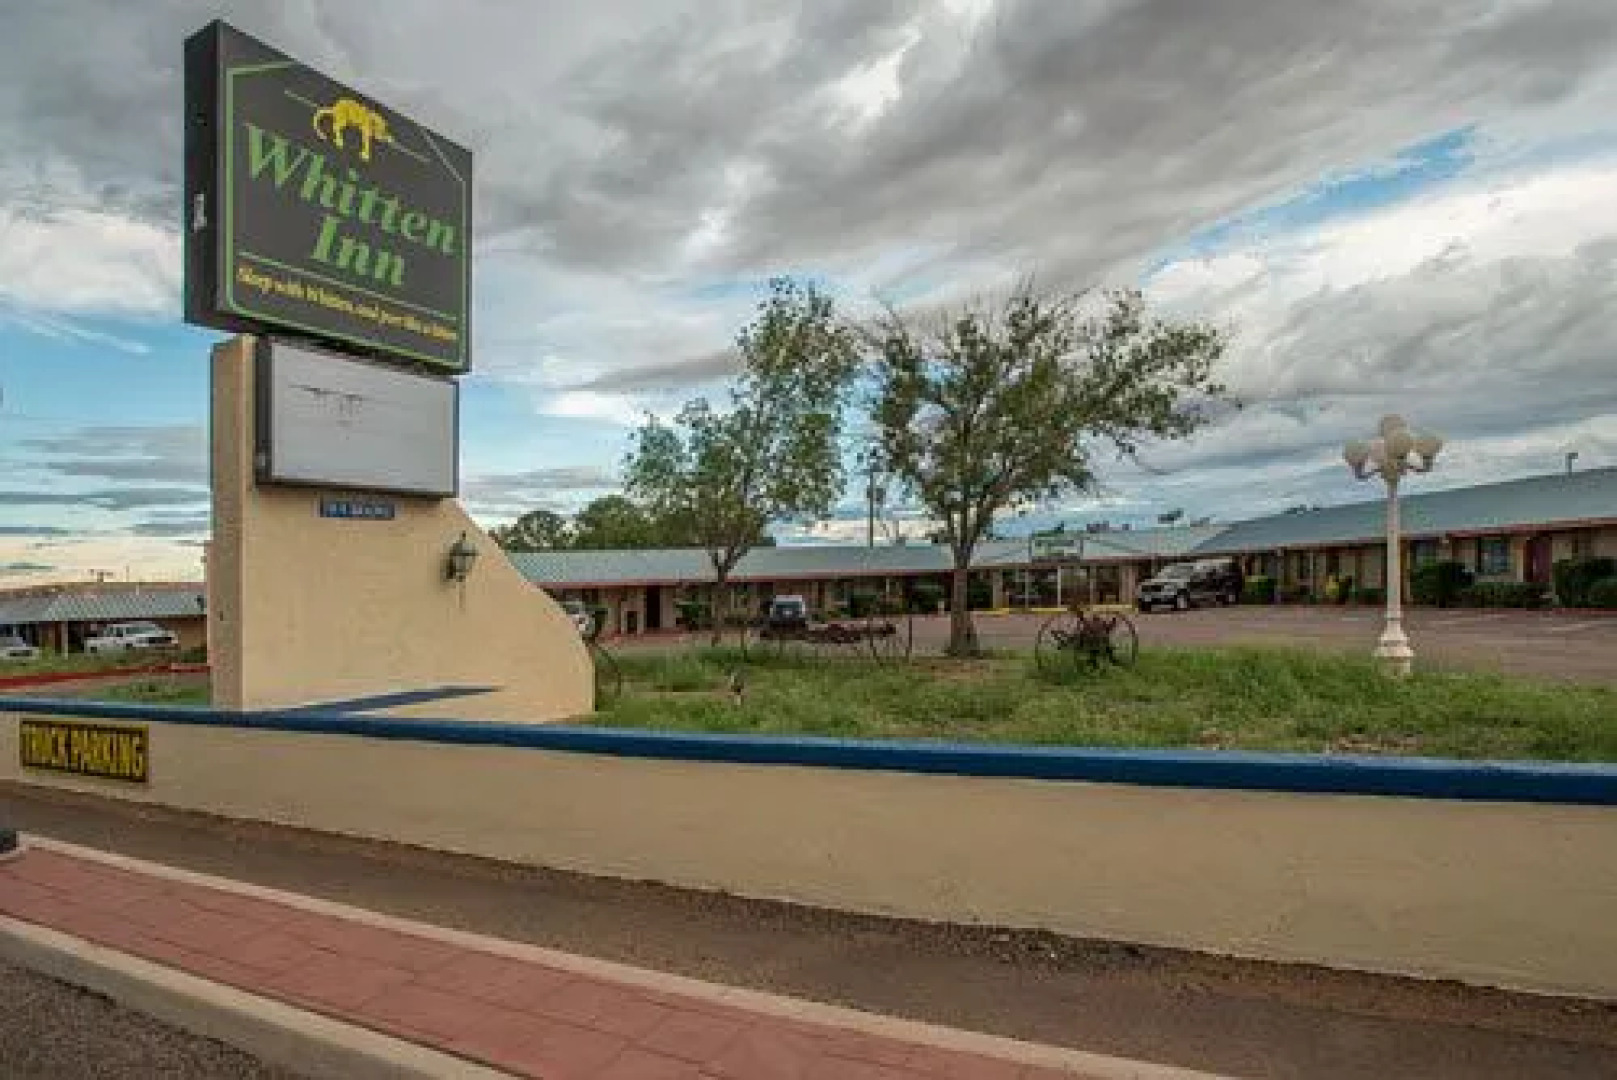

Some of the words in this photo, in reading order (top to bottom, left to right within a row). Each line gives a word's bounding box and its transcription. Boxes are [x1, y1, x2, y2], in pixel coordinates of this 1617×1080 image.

[245, 123, 455, 254] Whitten
[311, 216, 404, 286] Inn
[22, 724, 68, 769] TRUCK
[70, 728, 144, 778] PARKING
